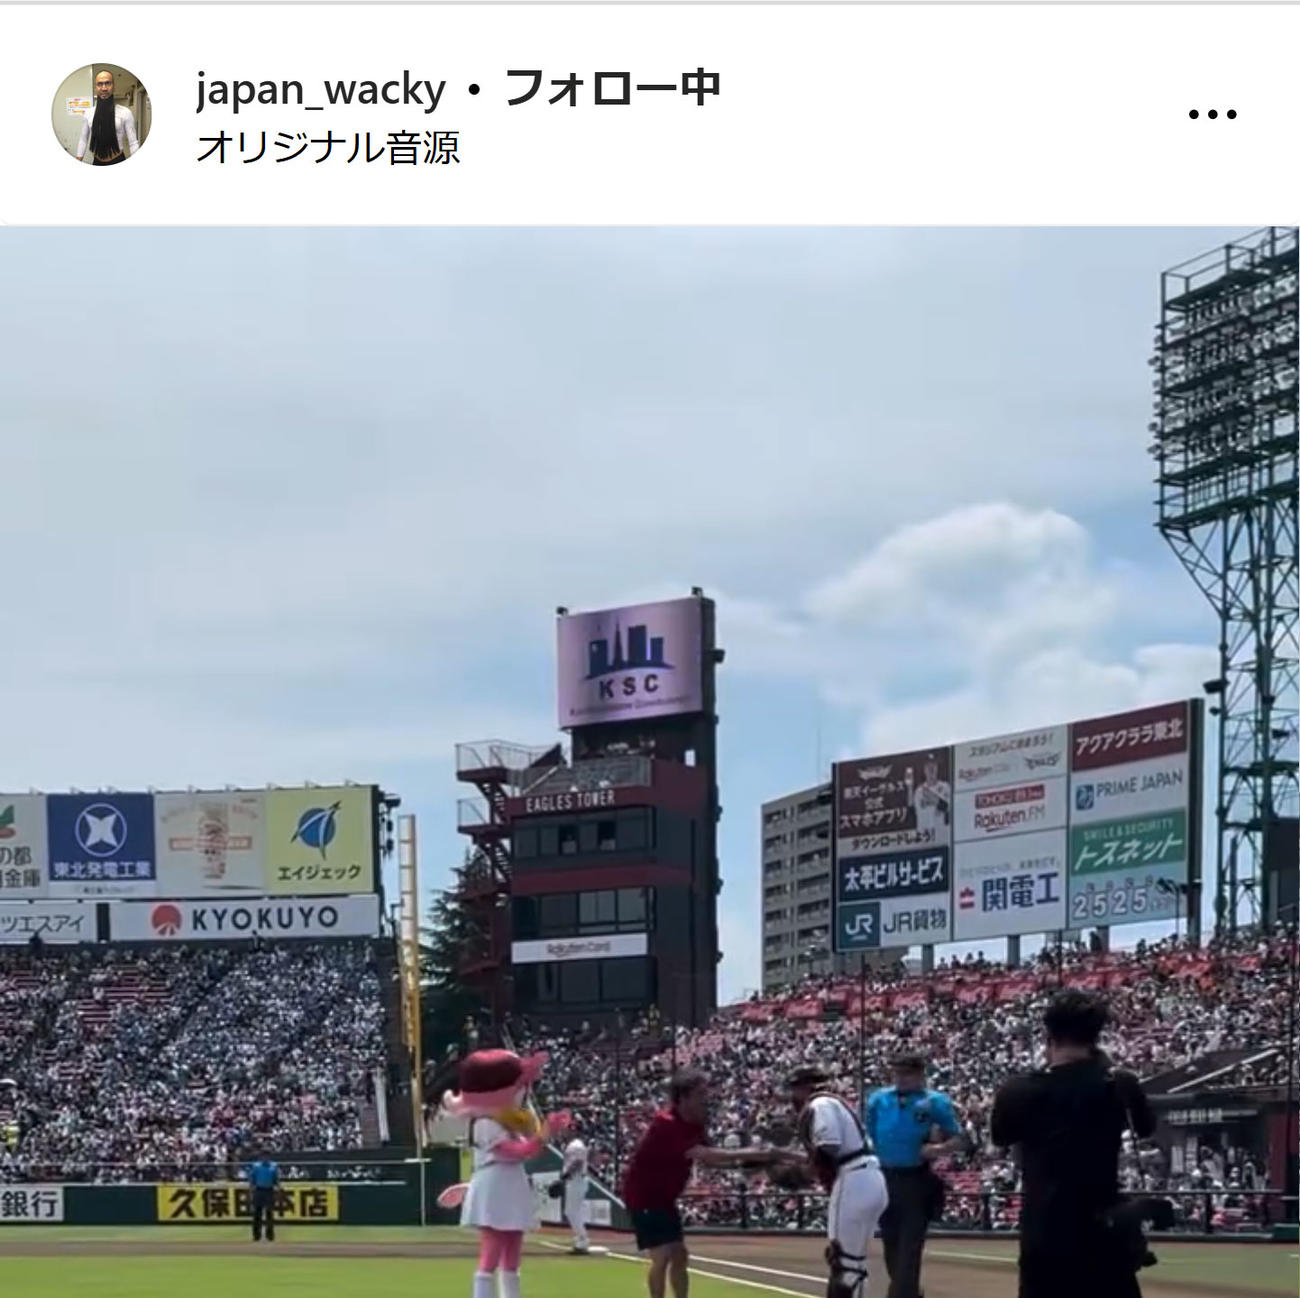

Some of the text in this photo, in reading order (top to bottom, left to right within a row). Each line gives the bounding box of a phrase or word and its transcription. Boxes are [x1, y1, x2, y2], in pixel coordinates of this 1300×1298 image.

[599, 674, 659, 698] KSC
[1077, 718, 1183, 756] アクアクララ東北
[1097, 769, 1183, 798] PRIME JAPAN
[526, 790, 615, 813] EAGLES TOWER
[1074, 832, 1183, 871] トスネット
[0, 868, 41, 888] 金庫
[54, 861, 151, 878] 東北発電工業
[278, 865, 362, 881] エイジェック
[844, 857, 943, 892] 太平ビルサービス
[982, 872, 1060, 912] 関電工
[1073, 888, 1148, 919] 2525
[192, 906, 339, 932] KYOKUYO
[845, 913, 873, 935] JR
[2, 1190, 58, 1218] 銀行
